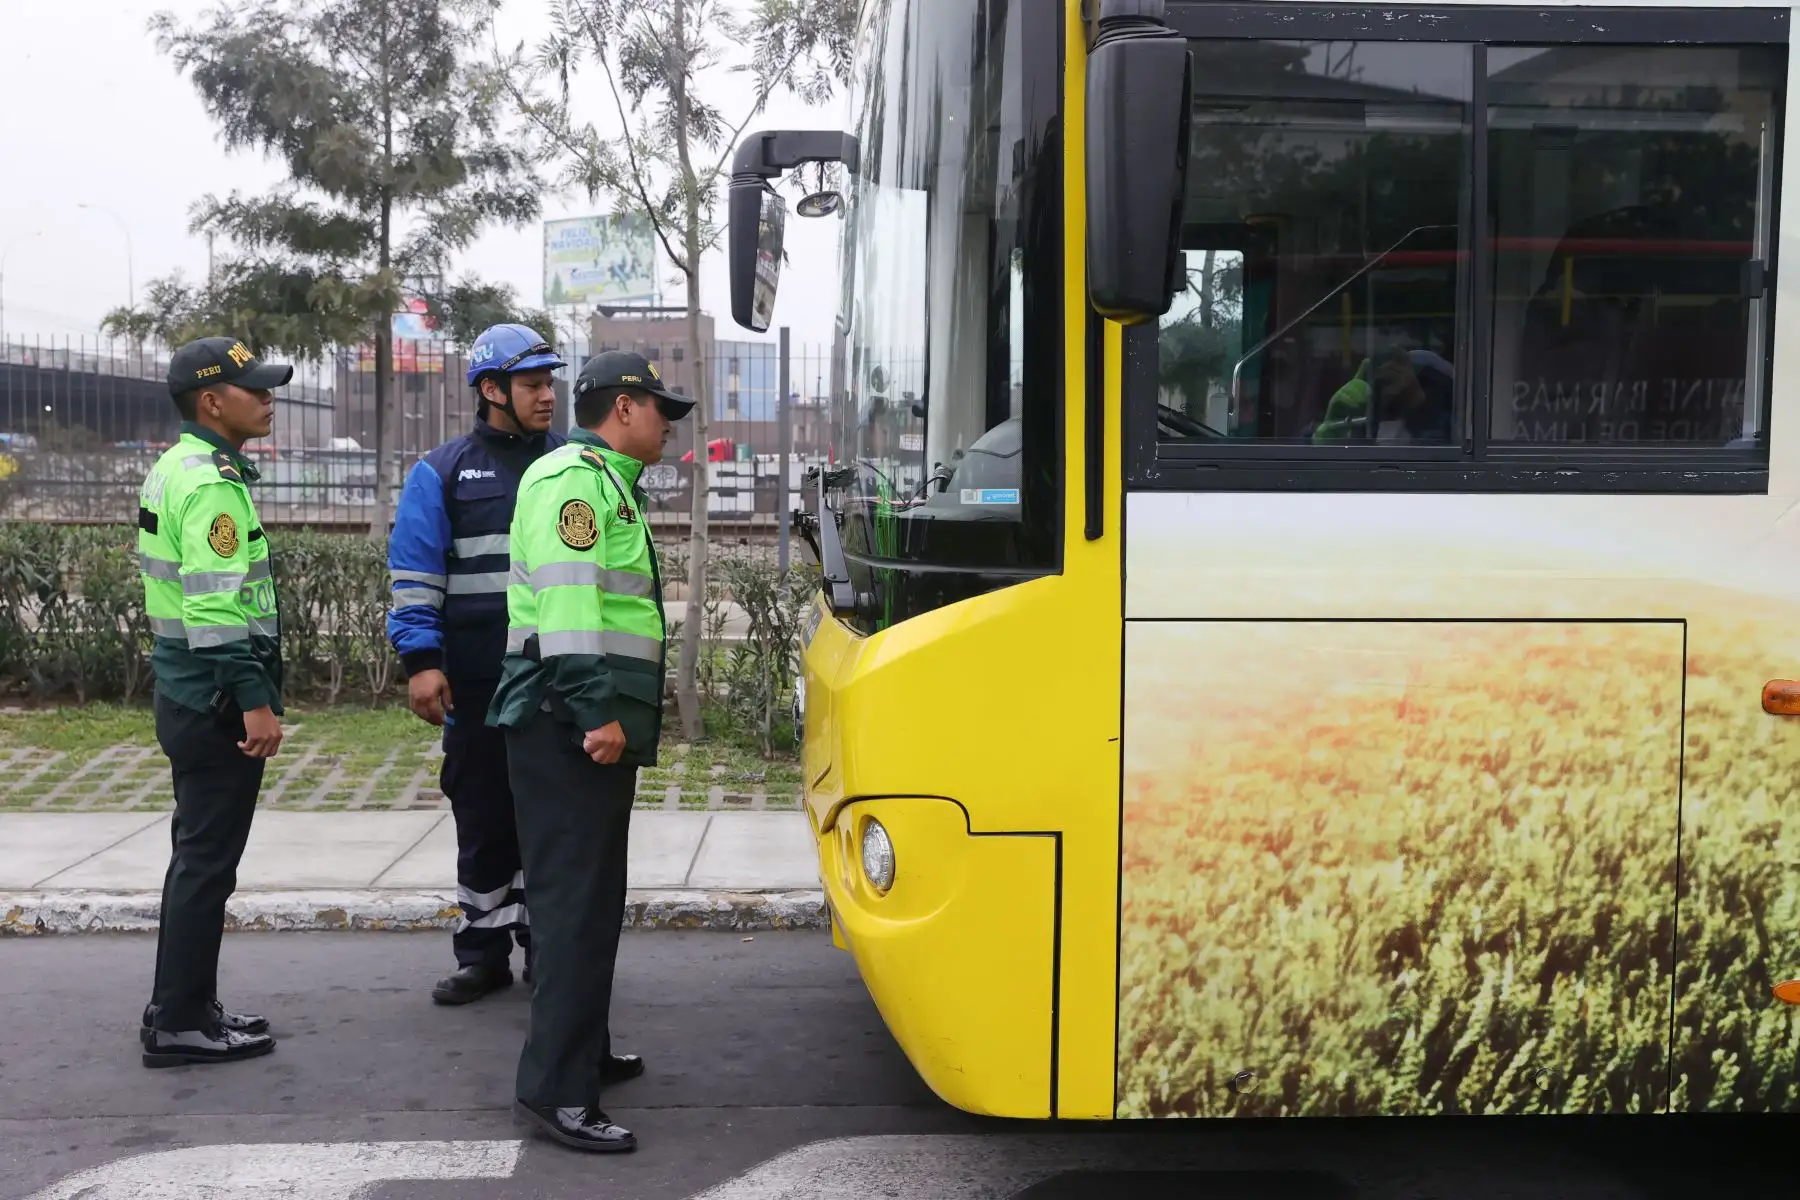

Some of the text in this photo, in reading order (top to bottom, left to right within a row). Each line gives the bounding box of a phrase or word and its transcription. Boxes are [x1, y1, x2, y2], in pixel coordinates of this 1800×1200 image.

[551, 236, 600, 249] NAVIDAD
[227, 340, 256, 368] POL
[196, 365, 222, 379] PERU
[621, 375, 642, 383] PERU
[458, 469, 481, 481] ATU
